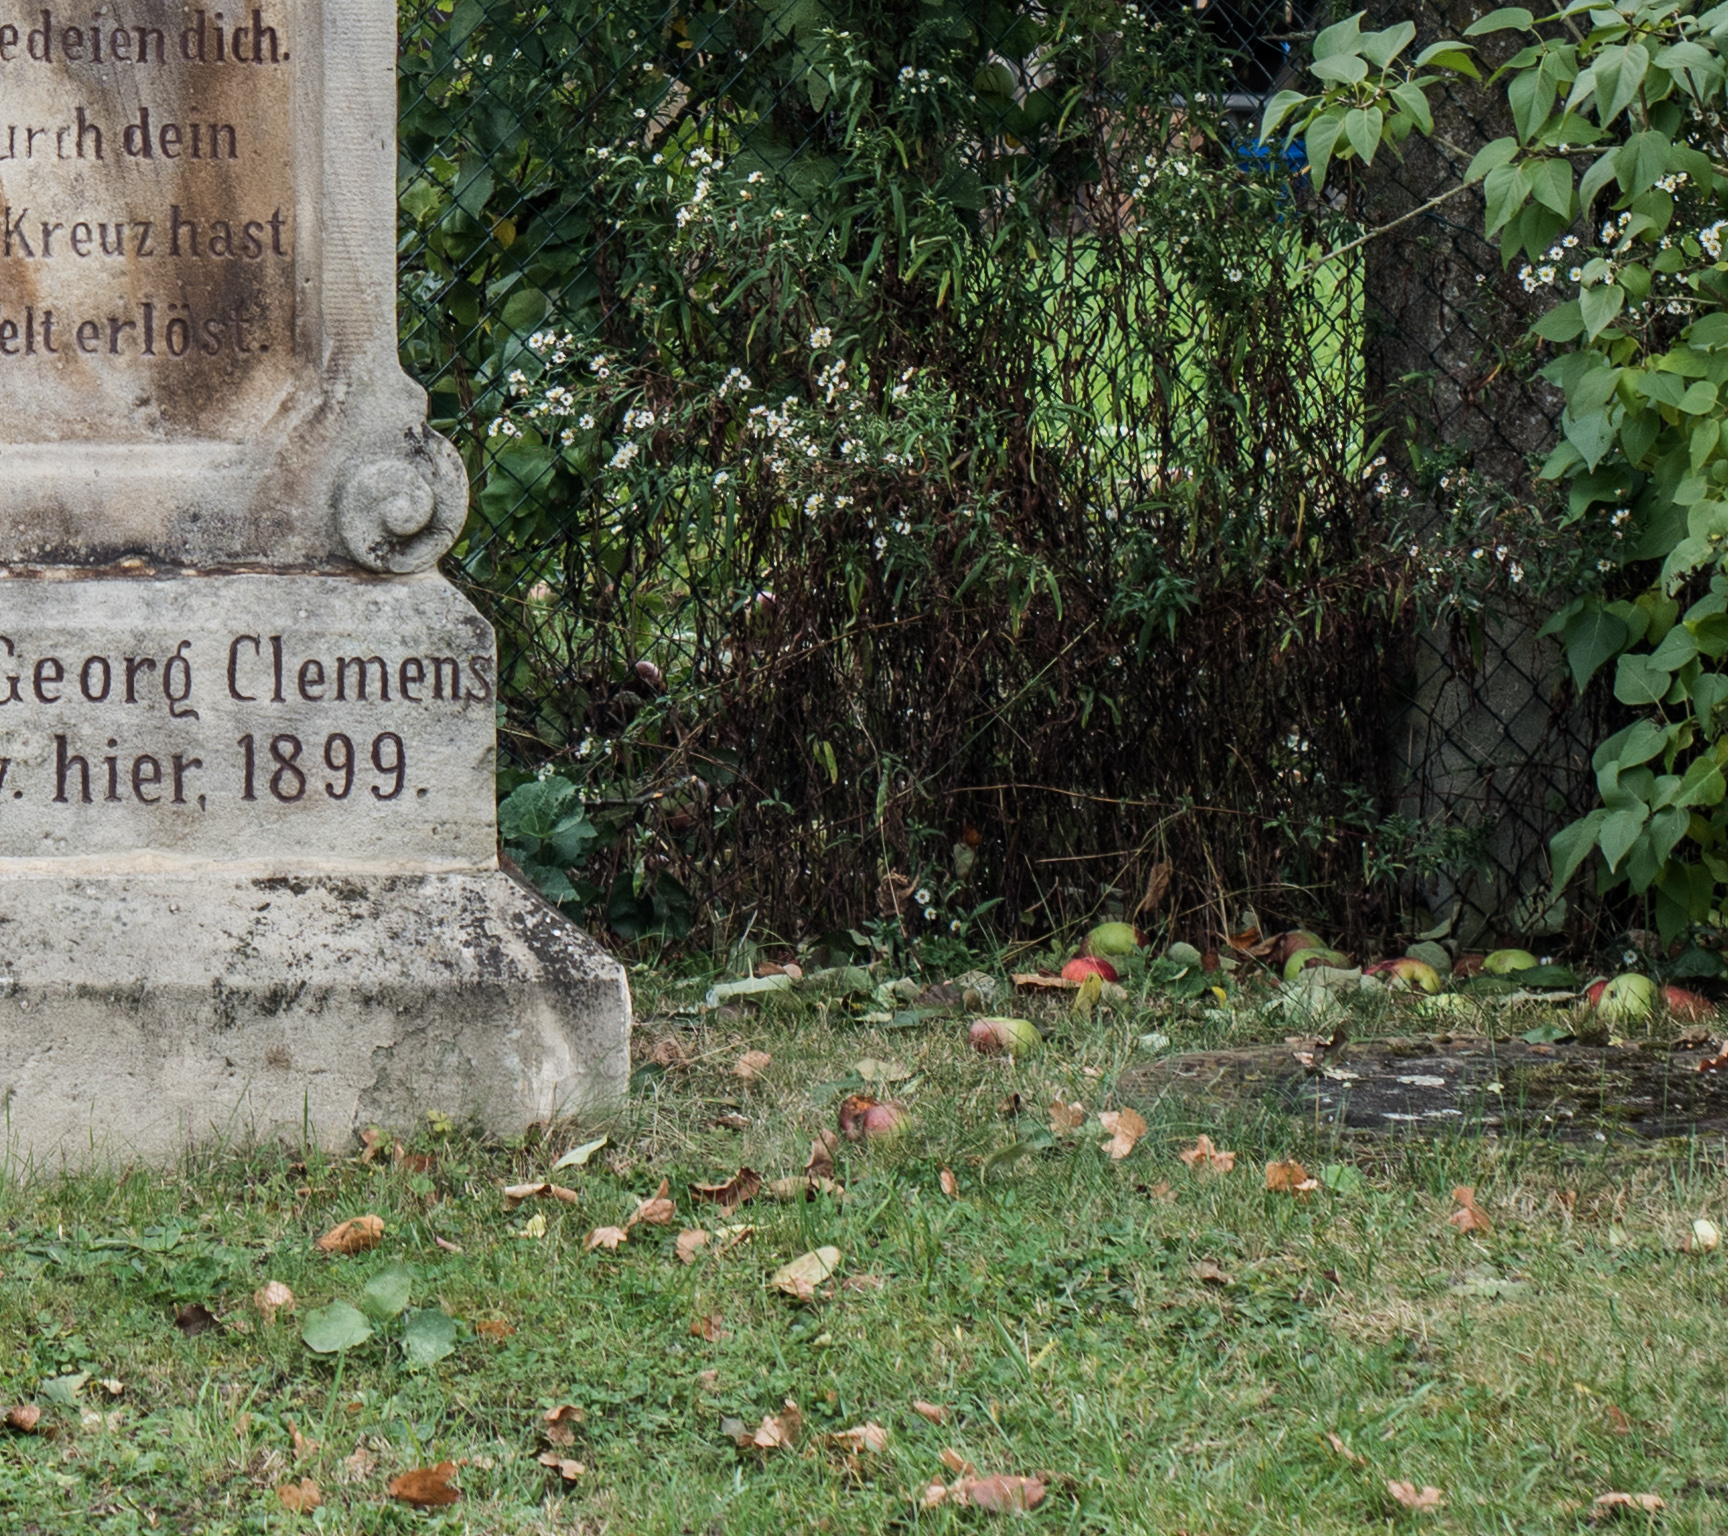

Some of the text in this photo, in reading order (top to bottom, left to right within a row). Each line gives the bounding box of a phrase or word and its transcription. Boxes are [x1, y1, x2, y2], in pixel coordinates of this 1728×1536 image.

[179, 10, 291, 65] dich.
[122, 106, 238, 160] dein
[3, 206, 154, 259] Kreuz
[171, 205, 289, 259] hast
[76, 302, 270, 358] erlöst.
[227, 634, 493, 703] Clemens
[52, 734, 207, 812] hier,
[237, 731, 429, 804] 1899.
